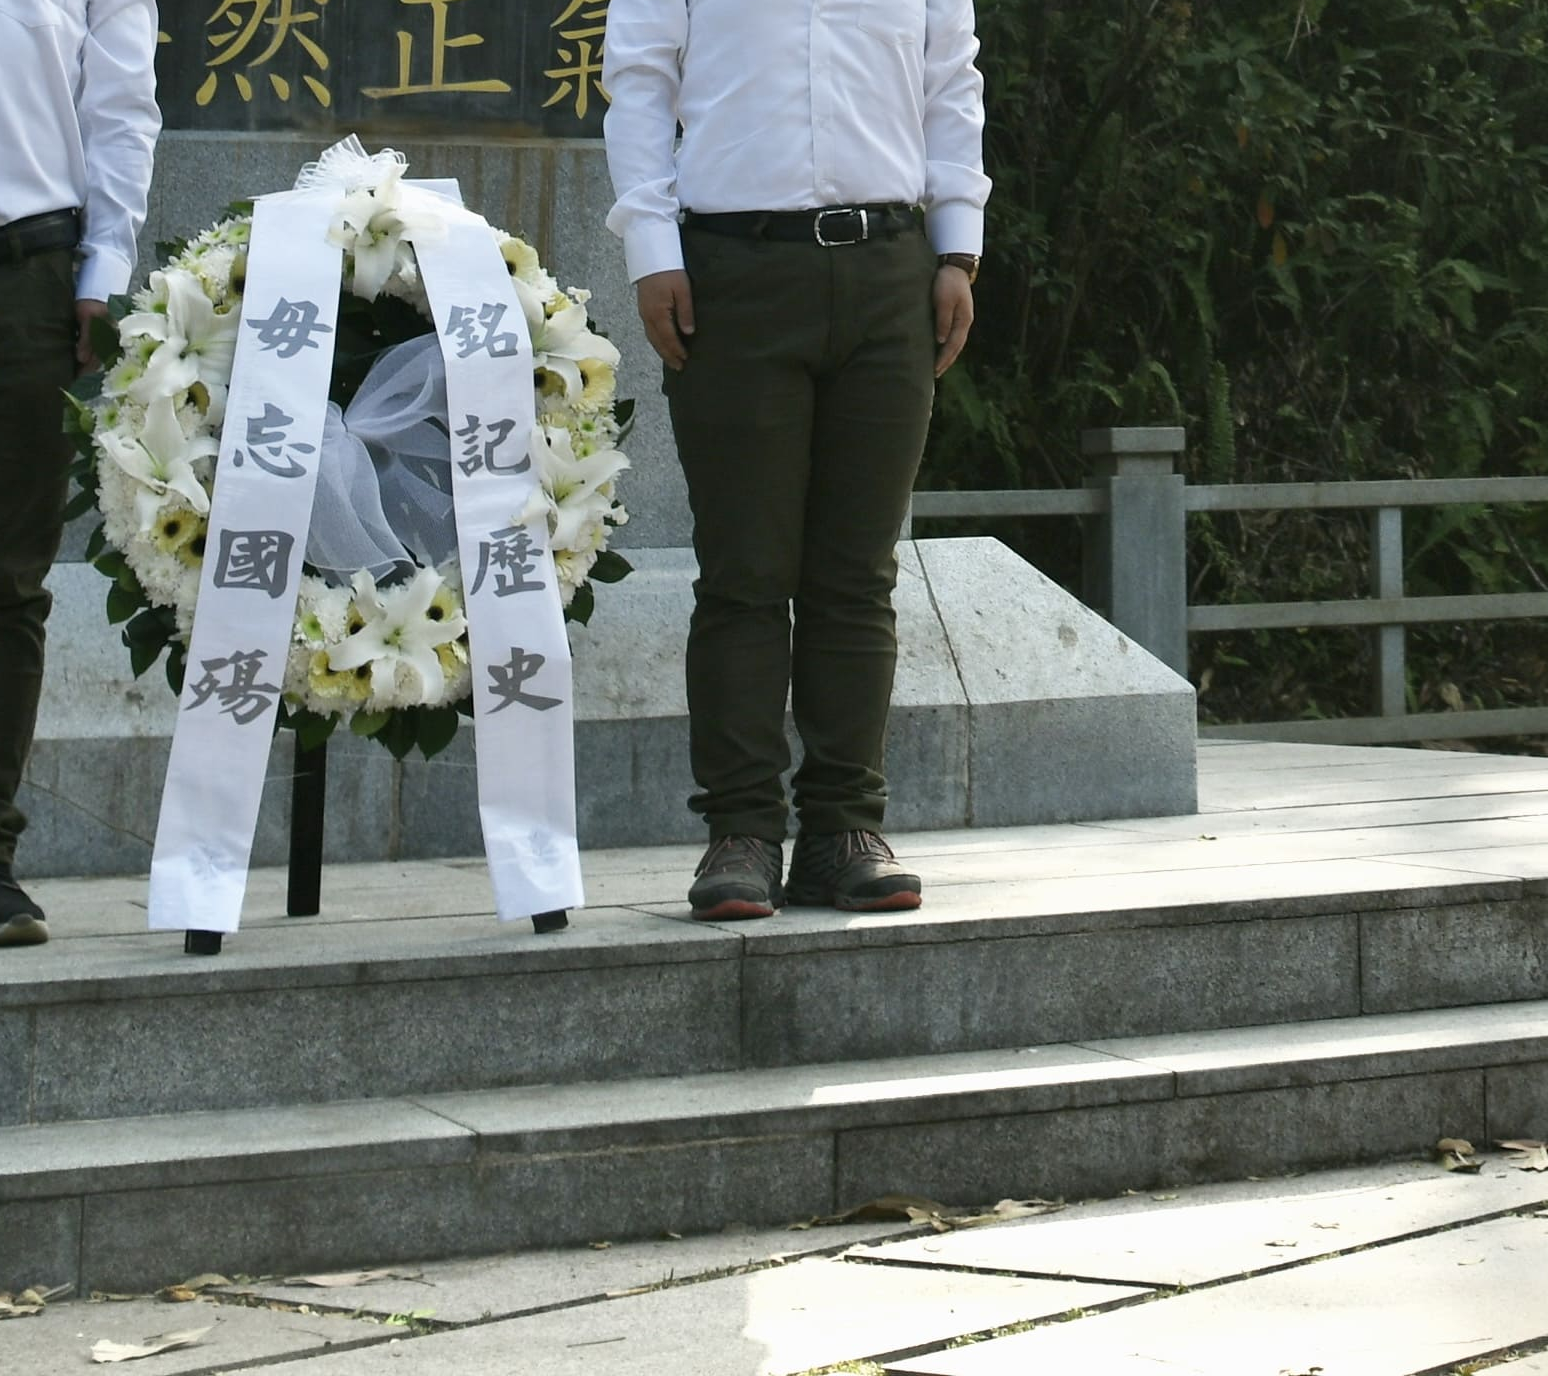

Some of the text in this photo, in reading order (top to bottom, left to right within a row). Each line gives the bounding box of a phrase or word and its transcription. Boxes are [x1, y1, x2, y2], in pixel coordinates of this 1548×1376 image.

[183, 296, 334, 726] 毋忘國殤
[444, 302, 564, 715] 銘記歷史
